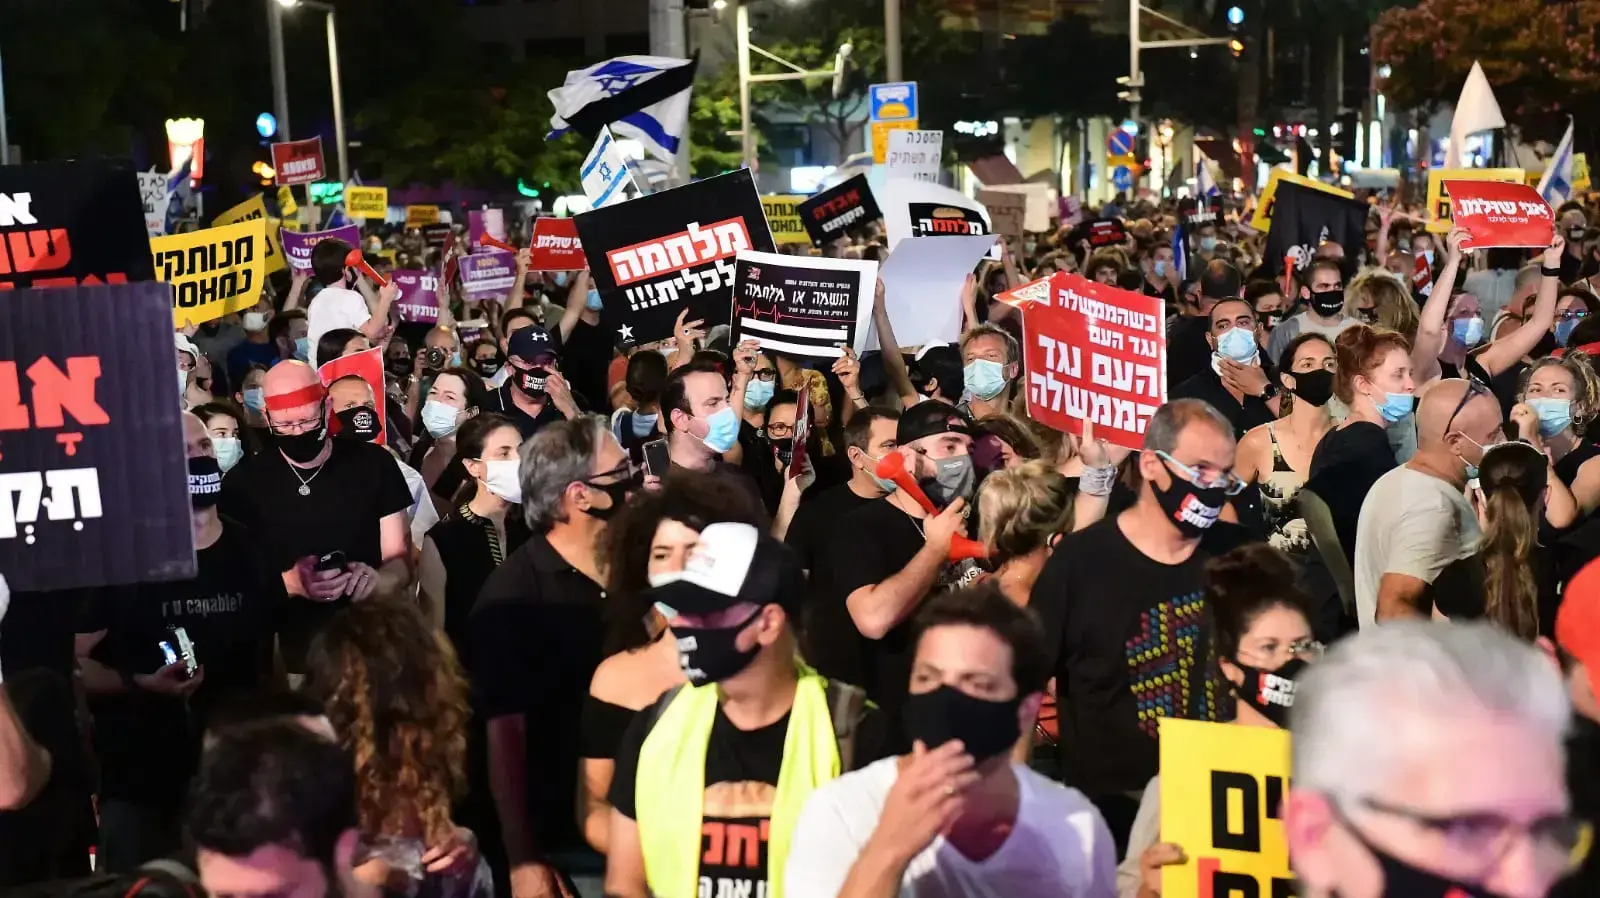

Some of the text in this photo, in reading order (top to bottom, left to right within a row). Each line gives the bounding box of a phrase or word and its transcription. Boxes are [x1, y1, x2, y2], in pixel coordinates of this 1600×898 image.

[919, 217, 983, 235] מלחמה
[155, 235, 254, 280] מנותקי
[611, 221, 750, 281] מלחמה
[171, 268, 253, 308] נמאס
[626, 260, 737, 312] לכלית!!!
[1058, 288, 1157, 333] כשהממשלה
[1089, 325, 1157, 358] נגד העם
[1038, 334, 1158, 398] העם נגד
[1031, 371, 1159, 434] הממשלה
[186, 591, 243, 618] capable?
